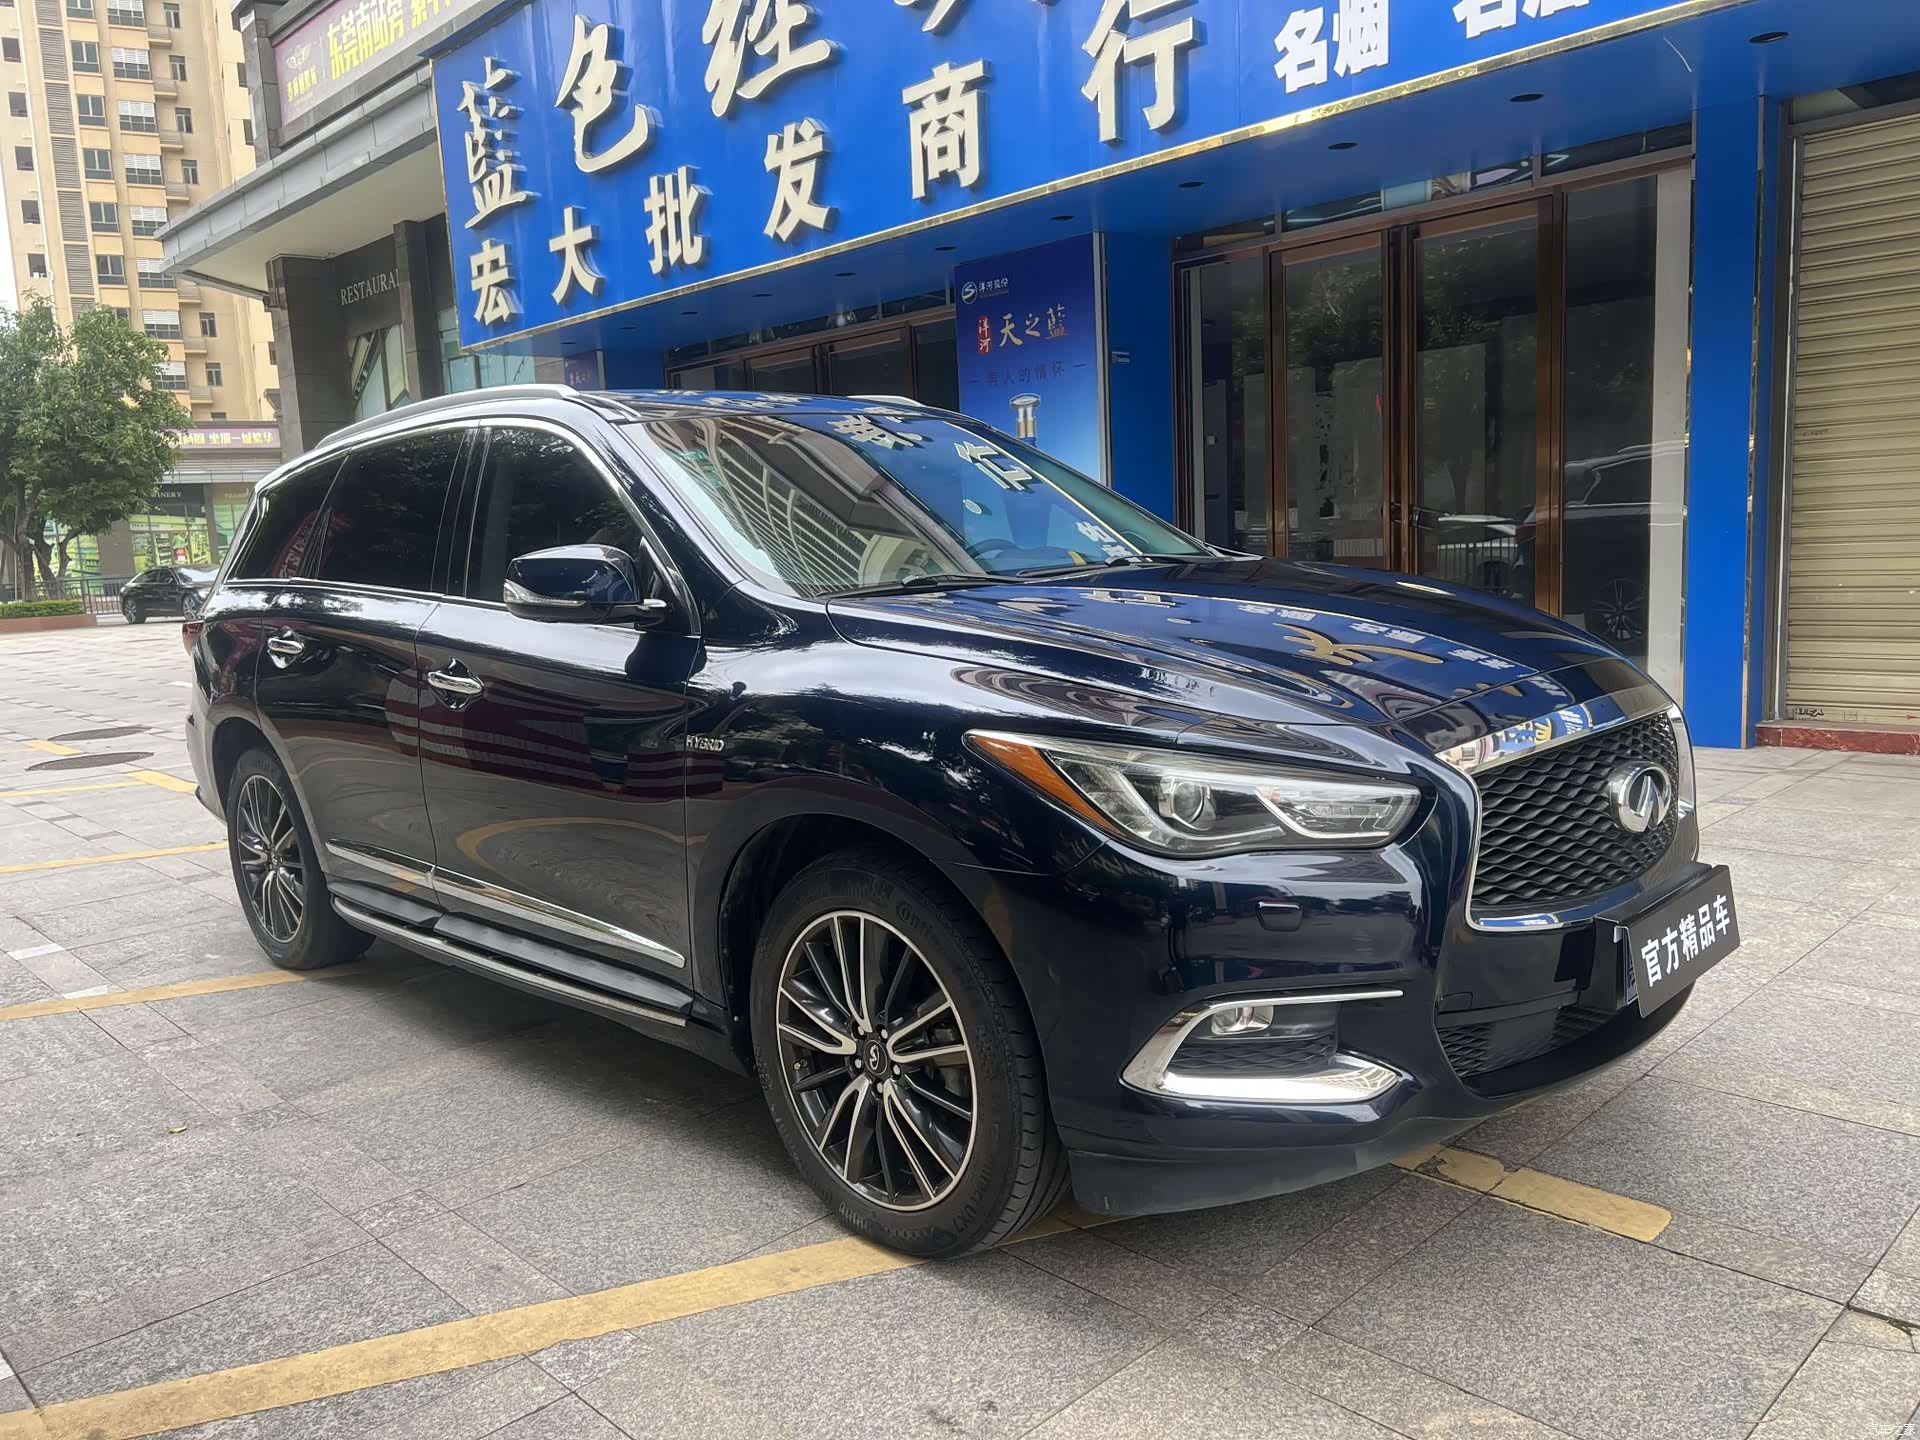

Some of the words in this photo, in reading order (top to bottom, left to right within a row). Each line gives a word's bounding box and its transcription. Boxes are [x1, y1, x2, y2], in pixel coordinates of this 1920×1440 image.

[470, 0, 1196, 326] 宏大批发商行
[978, 277, 1009, 292] 洋河股份
[978, 317, 991, 353] 洋河
[687, 735, 724, 751] HYBRID
[1641, 894, 1730, 987] 官方精品车
